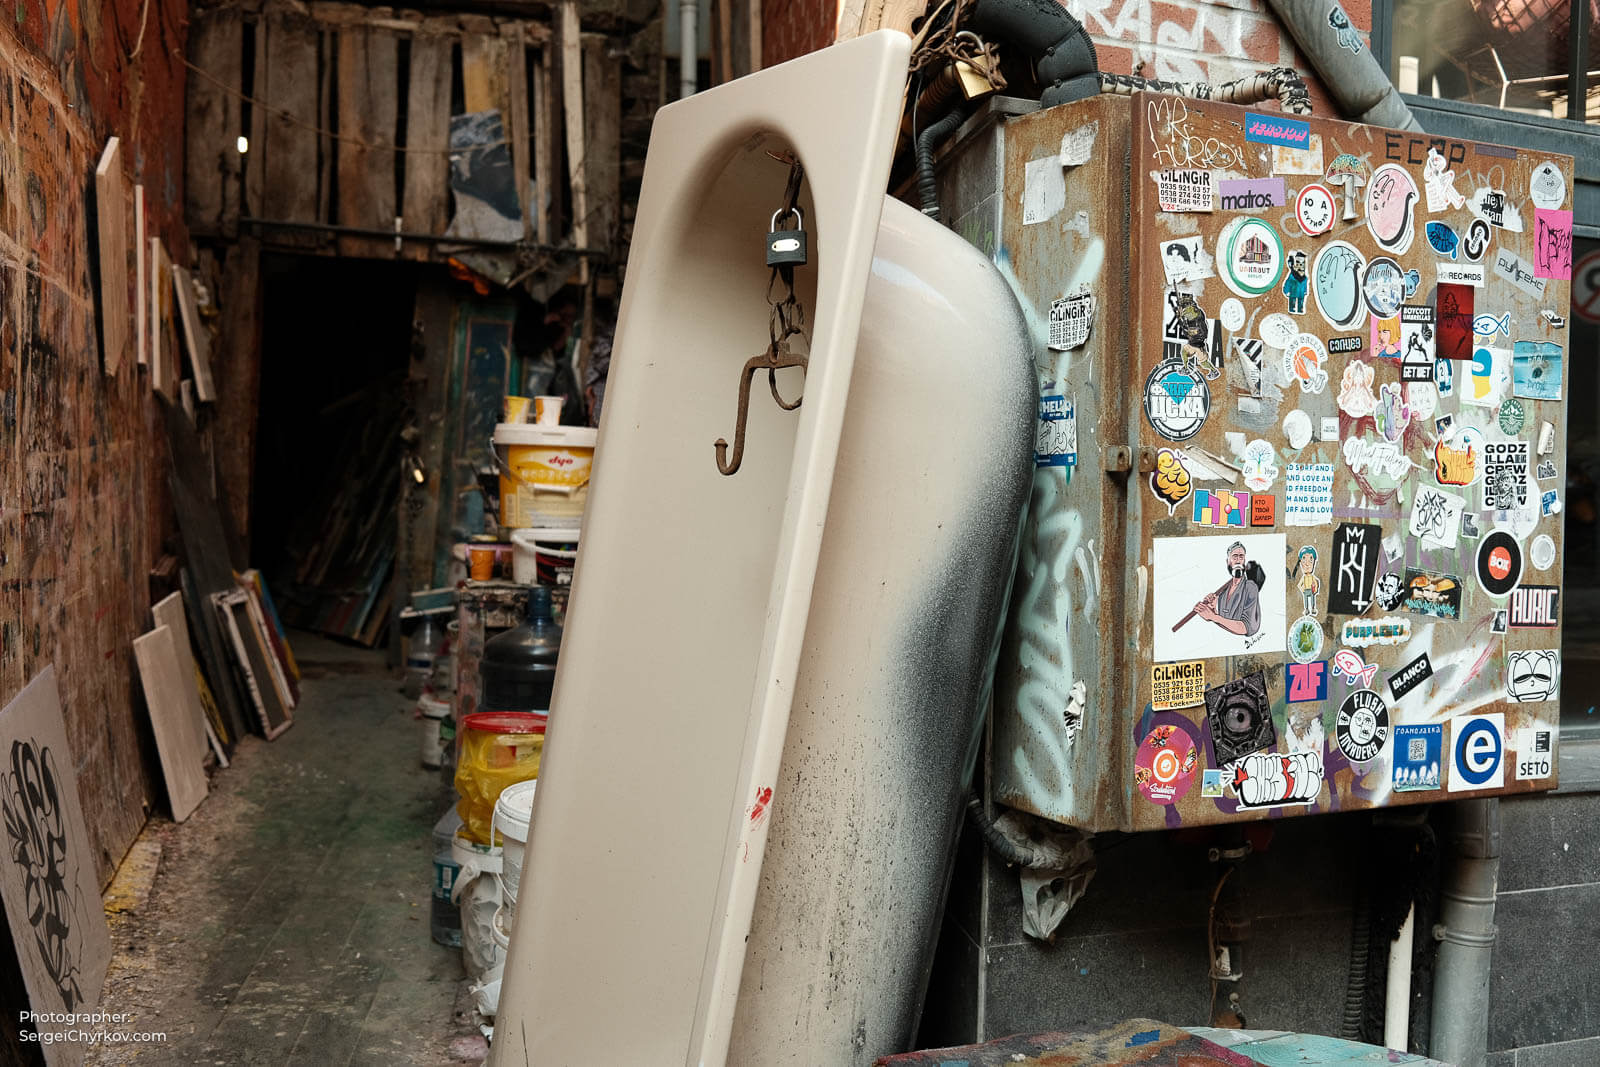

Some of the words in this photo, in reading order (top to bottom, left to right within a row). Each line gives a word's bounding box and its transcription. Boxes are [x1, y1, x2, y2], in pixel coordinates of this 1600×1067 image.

[1150, 382, 1205, 397] ФАНАТЫ
[1150, 395, 1205, 423] ЦСКА
[1485, 444, 1527, 453] GODZ
[548, 455, 574, 467] dyo
[1485, 454, 1514, 464] ILLA
[1295, 485, 1328, 493] FREEDOM
[1490, 555, 1510, 572] BOX
[1391, 659, 1427, 690] BLANCO
[1353, 693, 1385, 717] FLUSH
[1338, 732, 1378, 760] INVADERS
